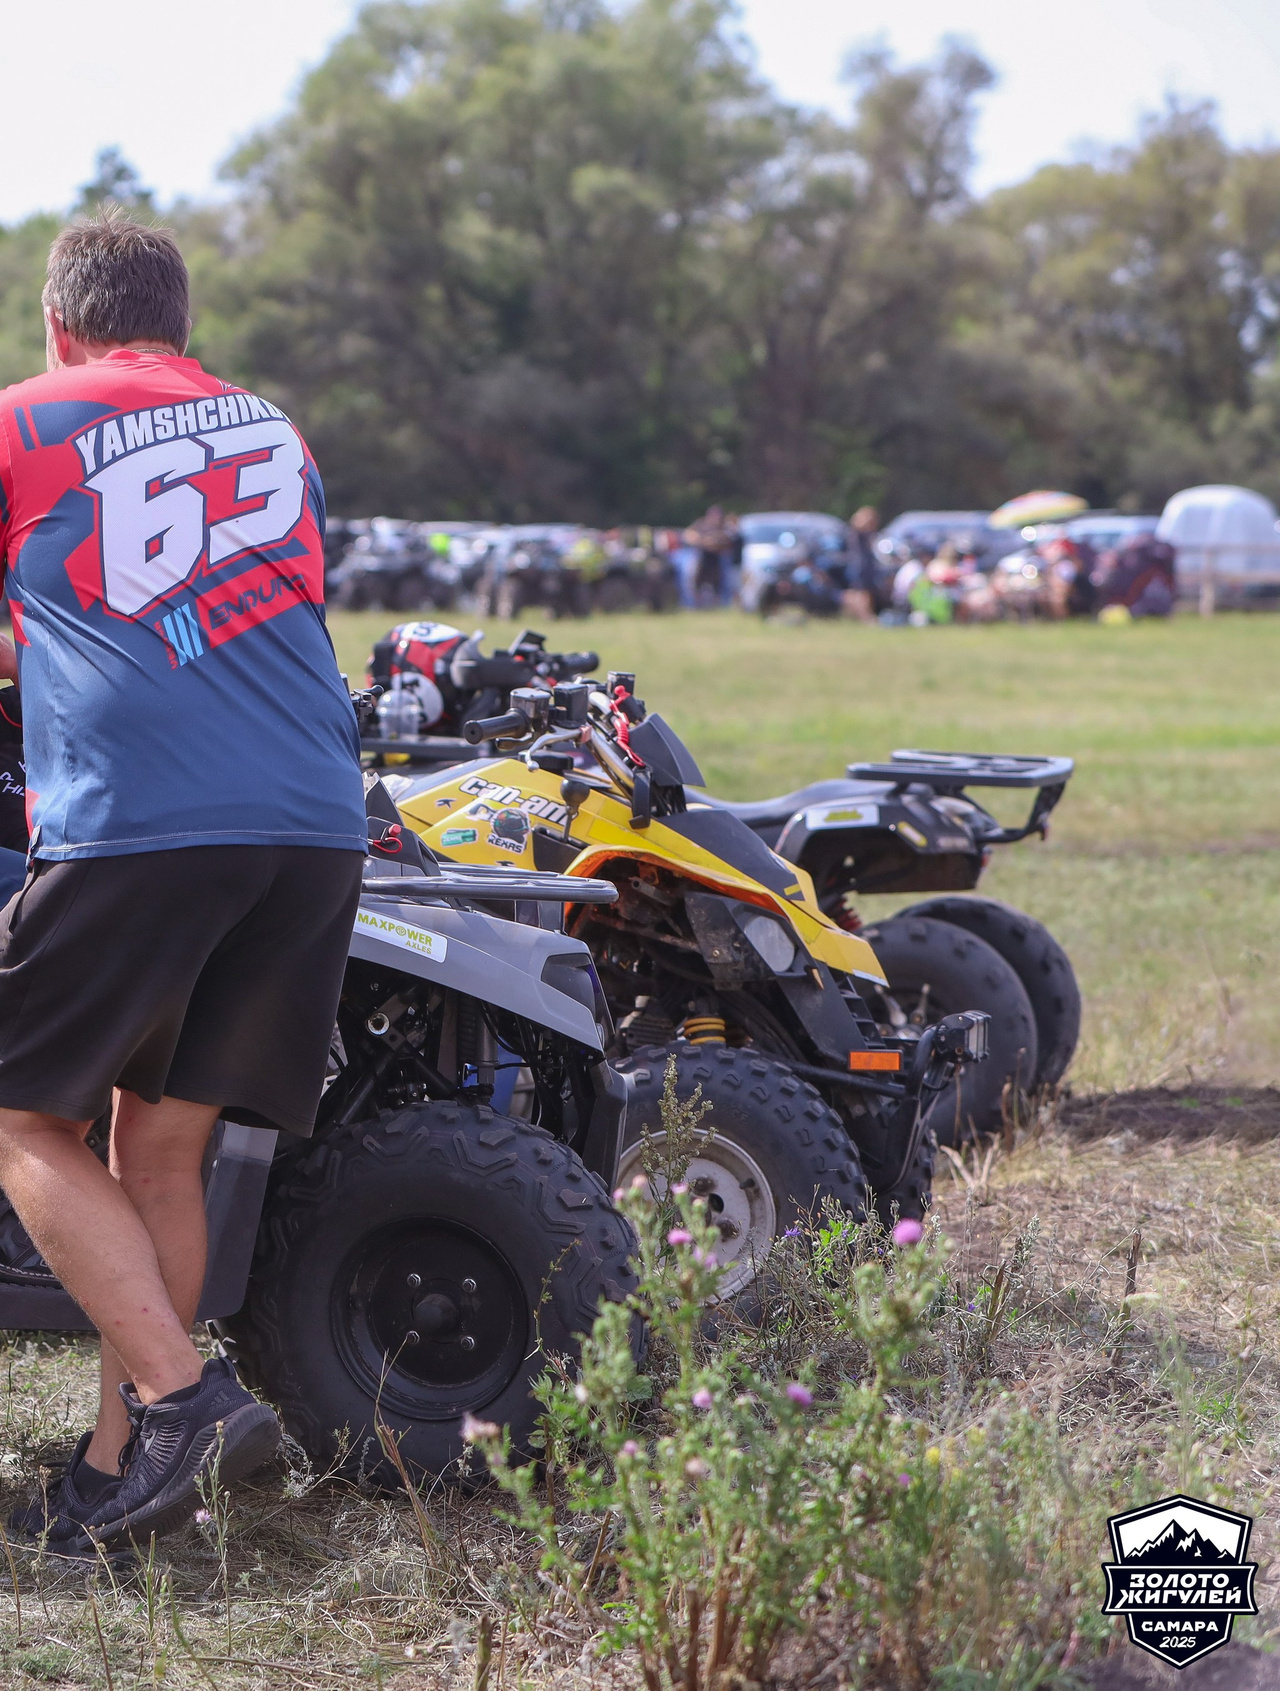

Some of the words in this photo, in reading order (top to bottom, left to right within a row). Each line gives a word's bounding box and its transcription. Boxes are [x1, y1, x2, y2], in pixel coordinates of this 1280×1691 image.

[83, 420, 306, 617] 63
[208, 573, 308, 631] ENDURO
[459, 775, 579, 827] can-am
[357, 912, 433, 948] MAXPOWER
[405, 940, 432, 955] AXLES
